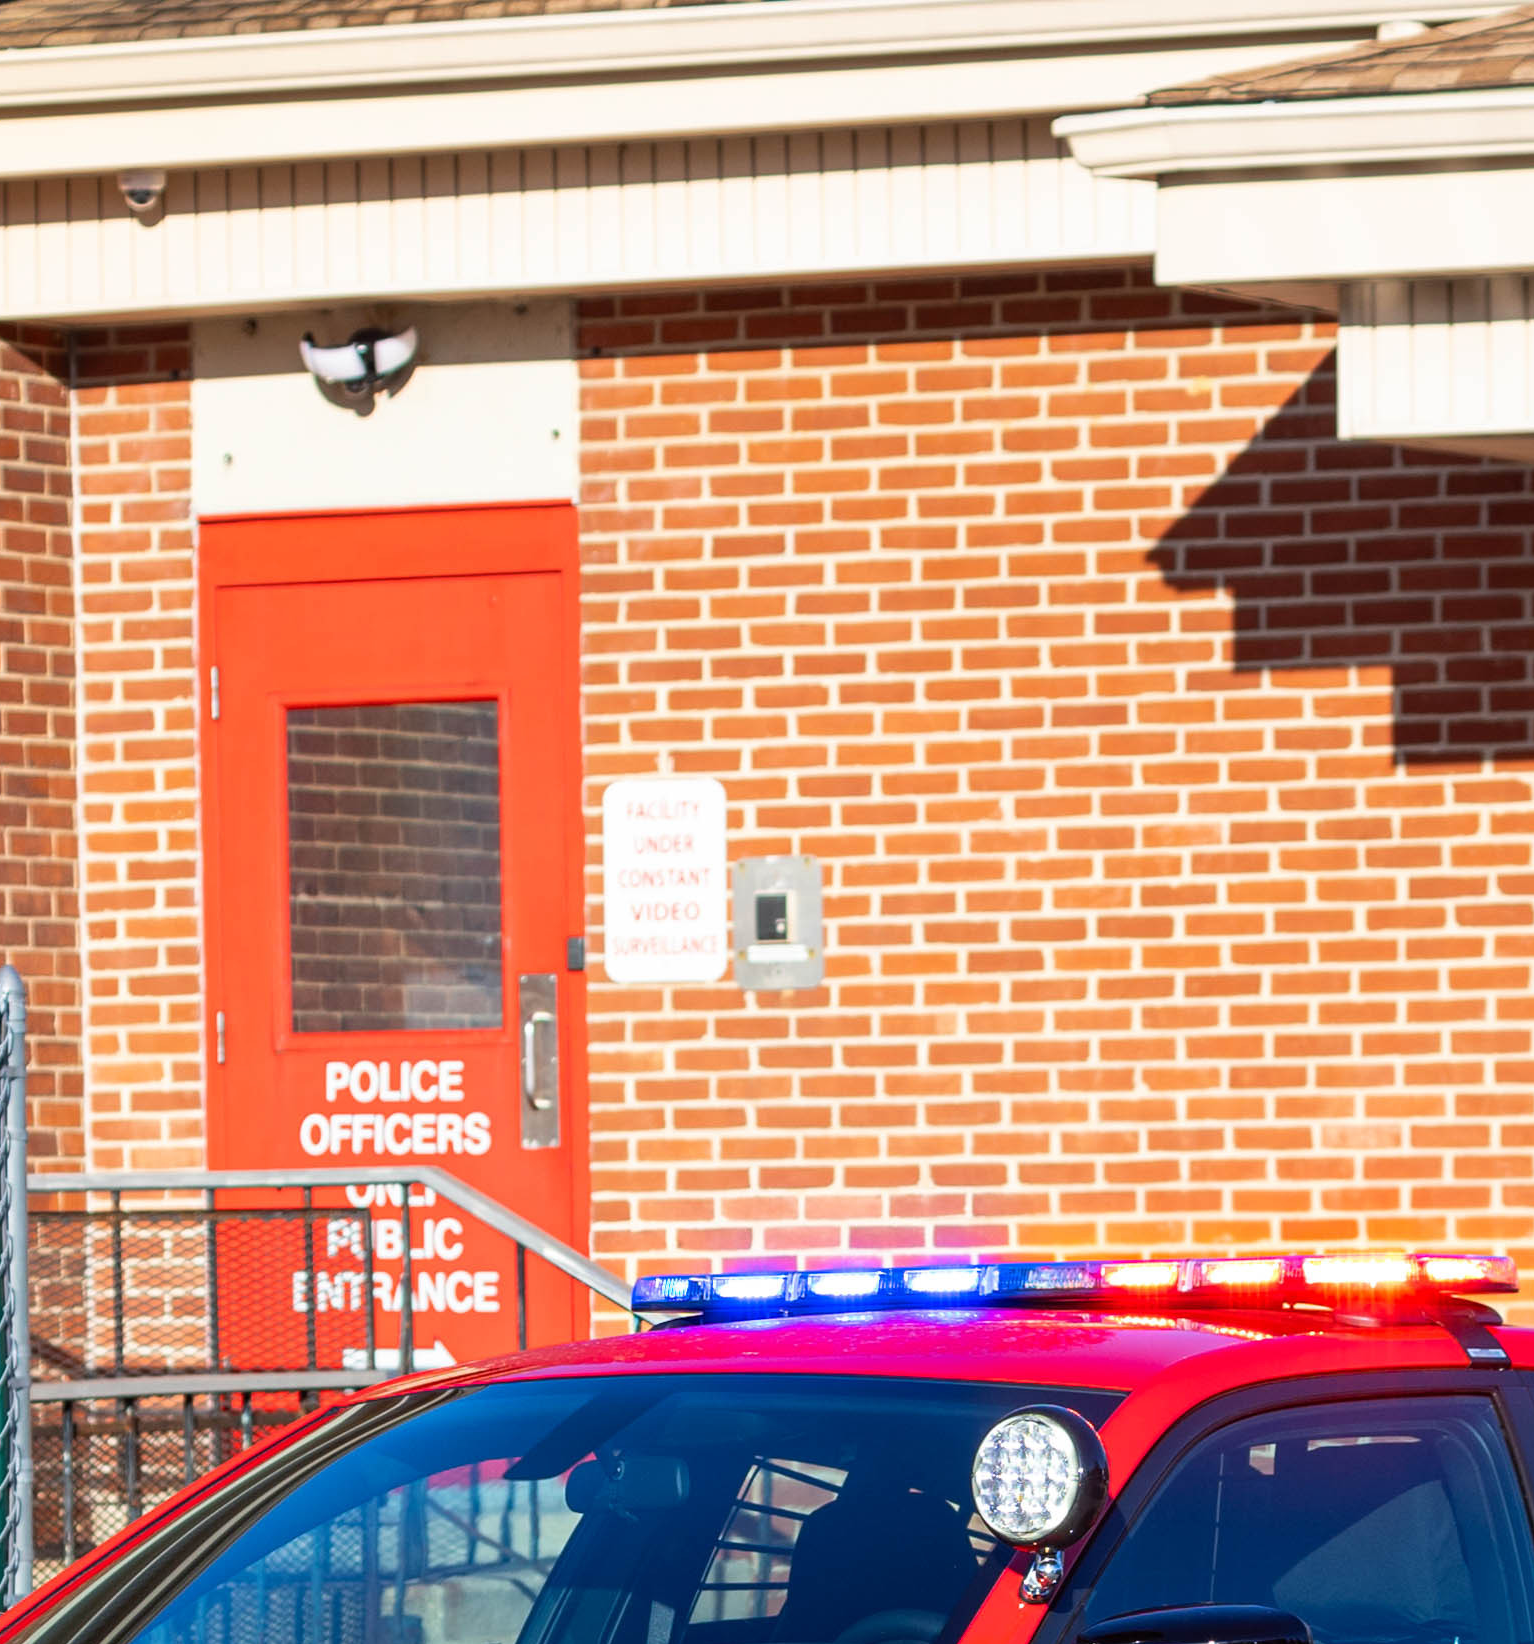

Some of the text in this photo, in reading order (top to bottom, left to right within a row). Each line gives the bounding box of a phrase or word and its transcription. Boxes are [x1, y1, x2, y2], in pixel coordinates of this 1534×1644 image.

[626, 800, 700, 821] FACILITY
[633, 834, 694, 855] UNDER
[618, 867, 711, 888] CONSTANT
[630, 902, 701, 921] VIDEO
[612, 934, 718, 955] SURVEILLANCE
[325, 1060, 465, 1103] POLICE
[300, 1112, 492, 1156] OFFICERS
[292, 1270, 500, 1313] ENTRANCE
